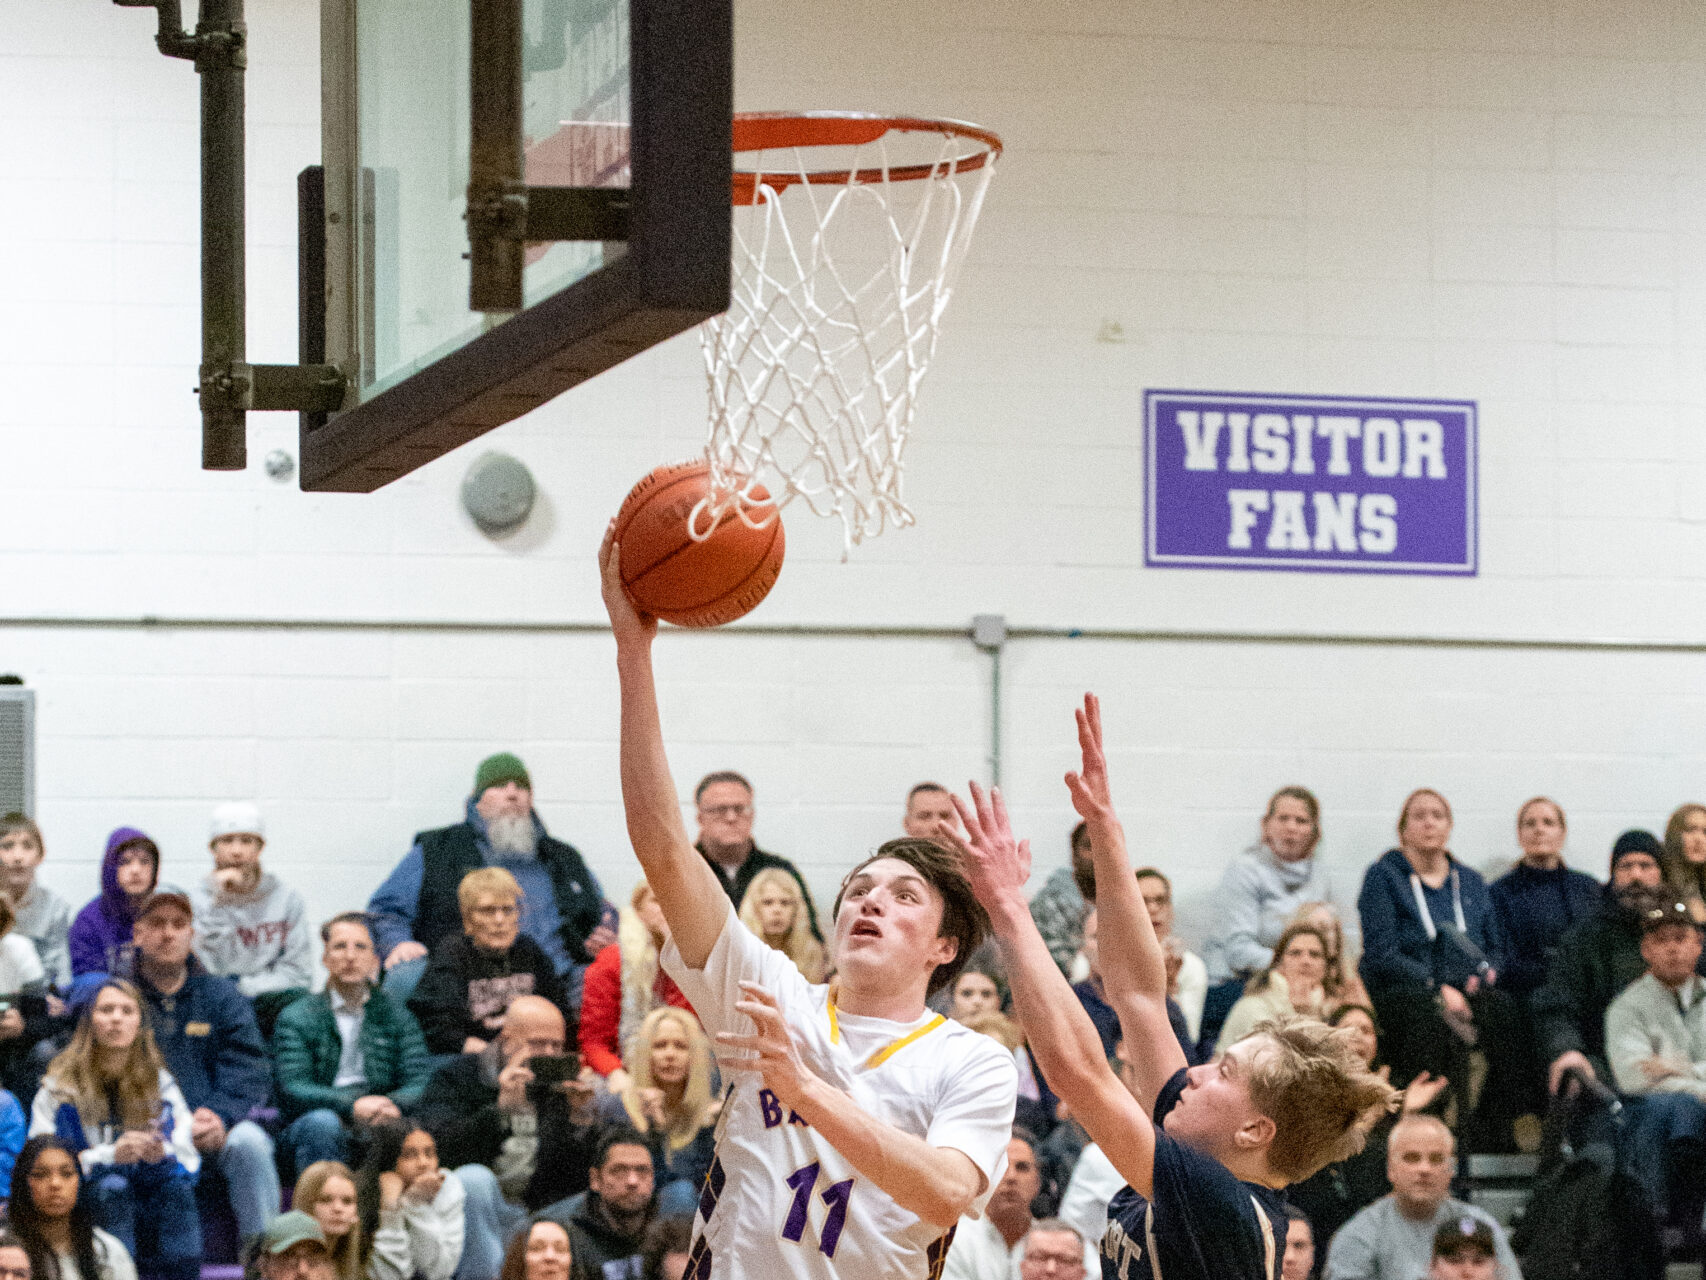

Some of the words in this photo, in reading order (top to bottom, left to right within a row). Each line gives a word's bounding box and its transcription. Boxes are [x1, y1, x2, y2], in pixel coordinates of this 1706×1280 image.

[1176, 410, 1448, 479] VISITOR
[1227, 488, 1399, 554] FANS
[779, 1159, 857, 1260] 11
